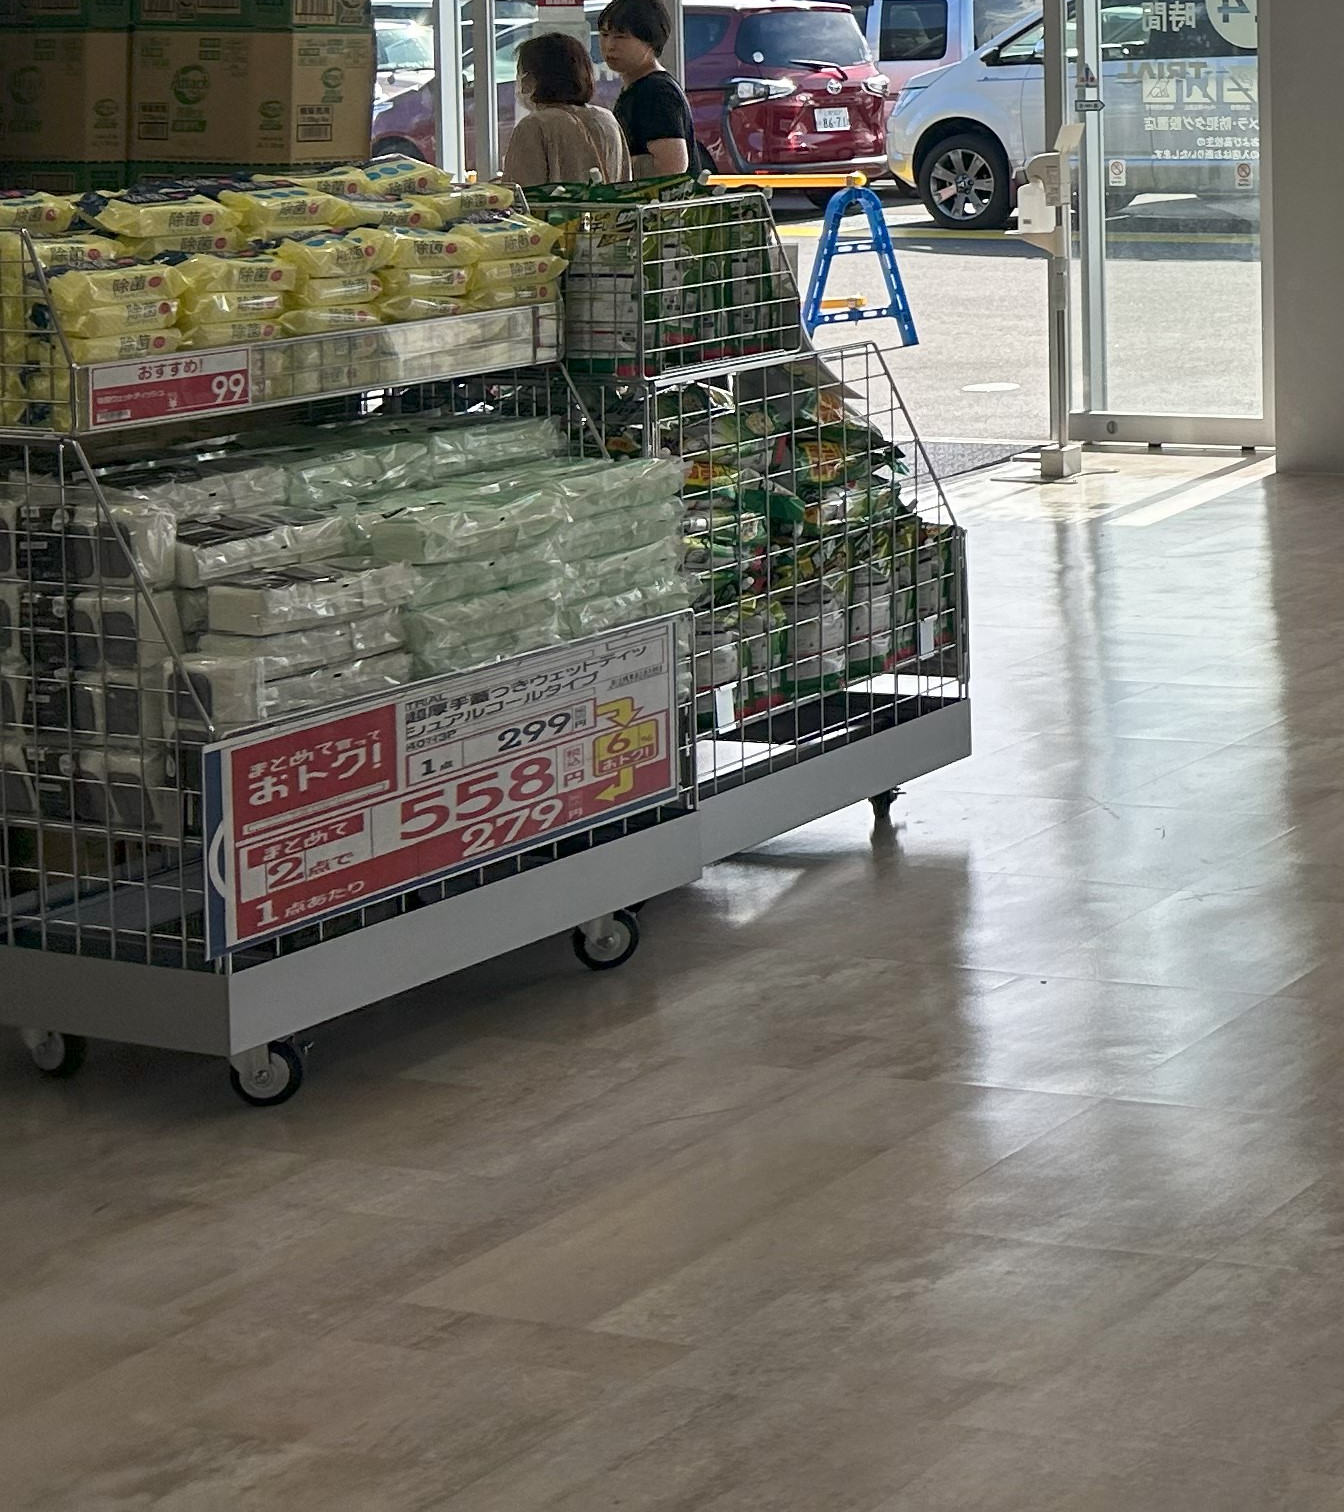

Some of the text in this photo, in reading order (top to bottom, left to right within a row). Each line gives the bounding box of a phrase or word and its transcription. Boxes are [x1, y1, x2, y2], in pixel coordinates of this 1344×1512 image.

[169, 211, 201, 228] 除菌
[181, 237, 213, 252] 除菌
[414, 240, 444, 255] 除菌
[113, 277, 146, 294] 除菌
[239, 267, 272, 283] 除菌
[127, 303, 158, 319] 除菌
[232, 323, 262, 338] 除菌
[137, 358, 204, 381] おすすめ!
[211, 372, 245, 403] 99
[405, 692, 448, 712] TRIAL
[497, 712, 571, 753] 299
[607, 731, 631, 754] 6
[601, 746, 651, 771] おトク!
[248, 742, 382, 806] おトク!
[400, 756, 585, 841] 558 円
[461, 798, 564, 858] 279
[263, 822, 349, 862] まとめて
[268, 855, 304, 889] 2
